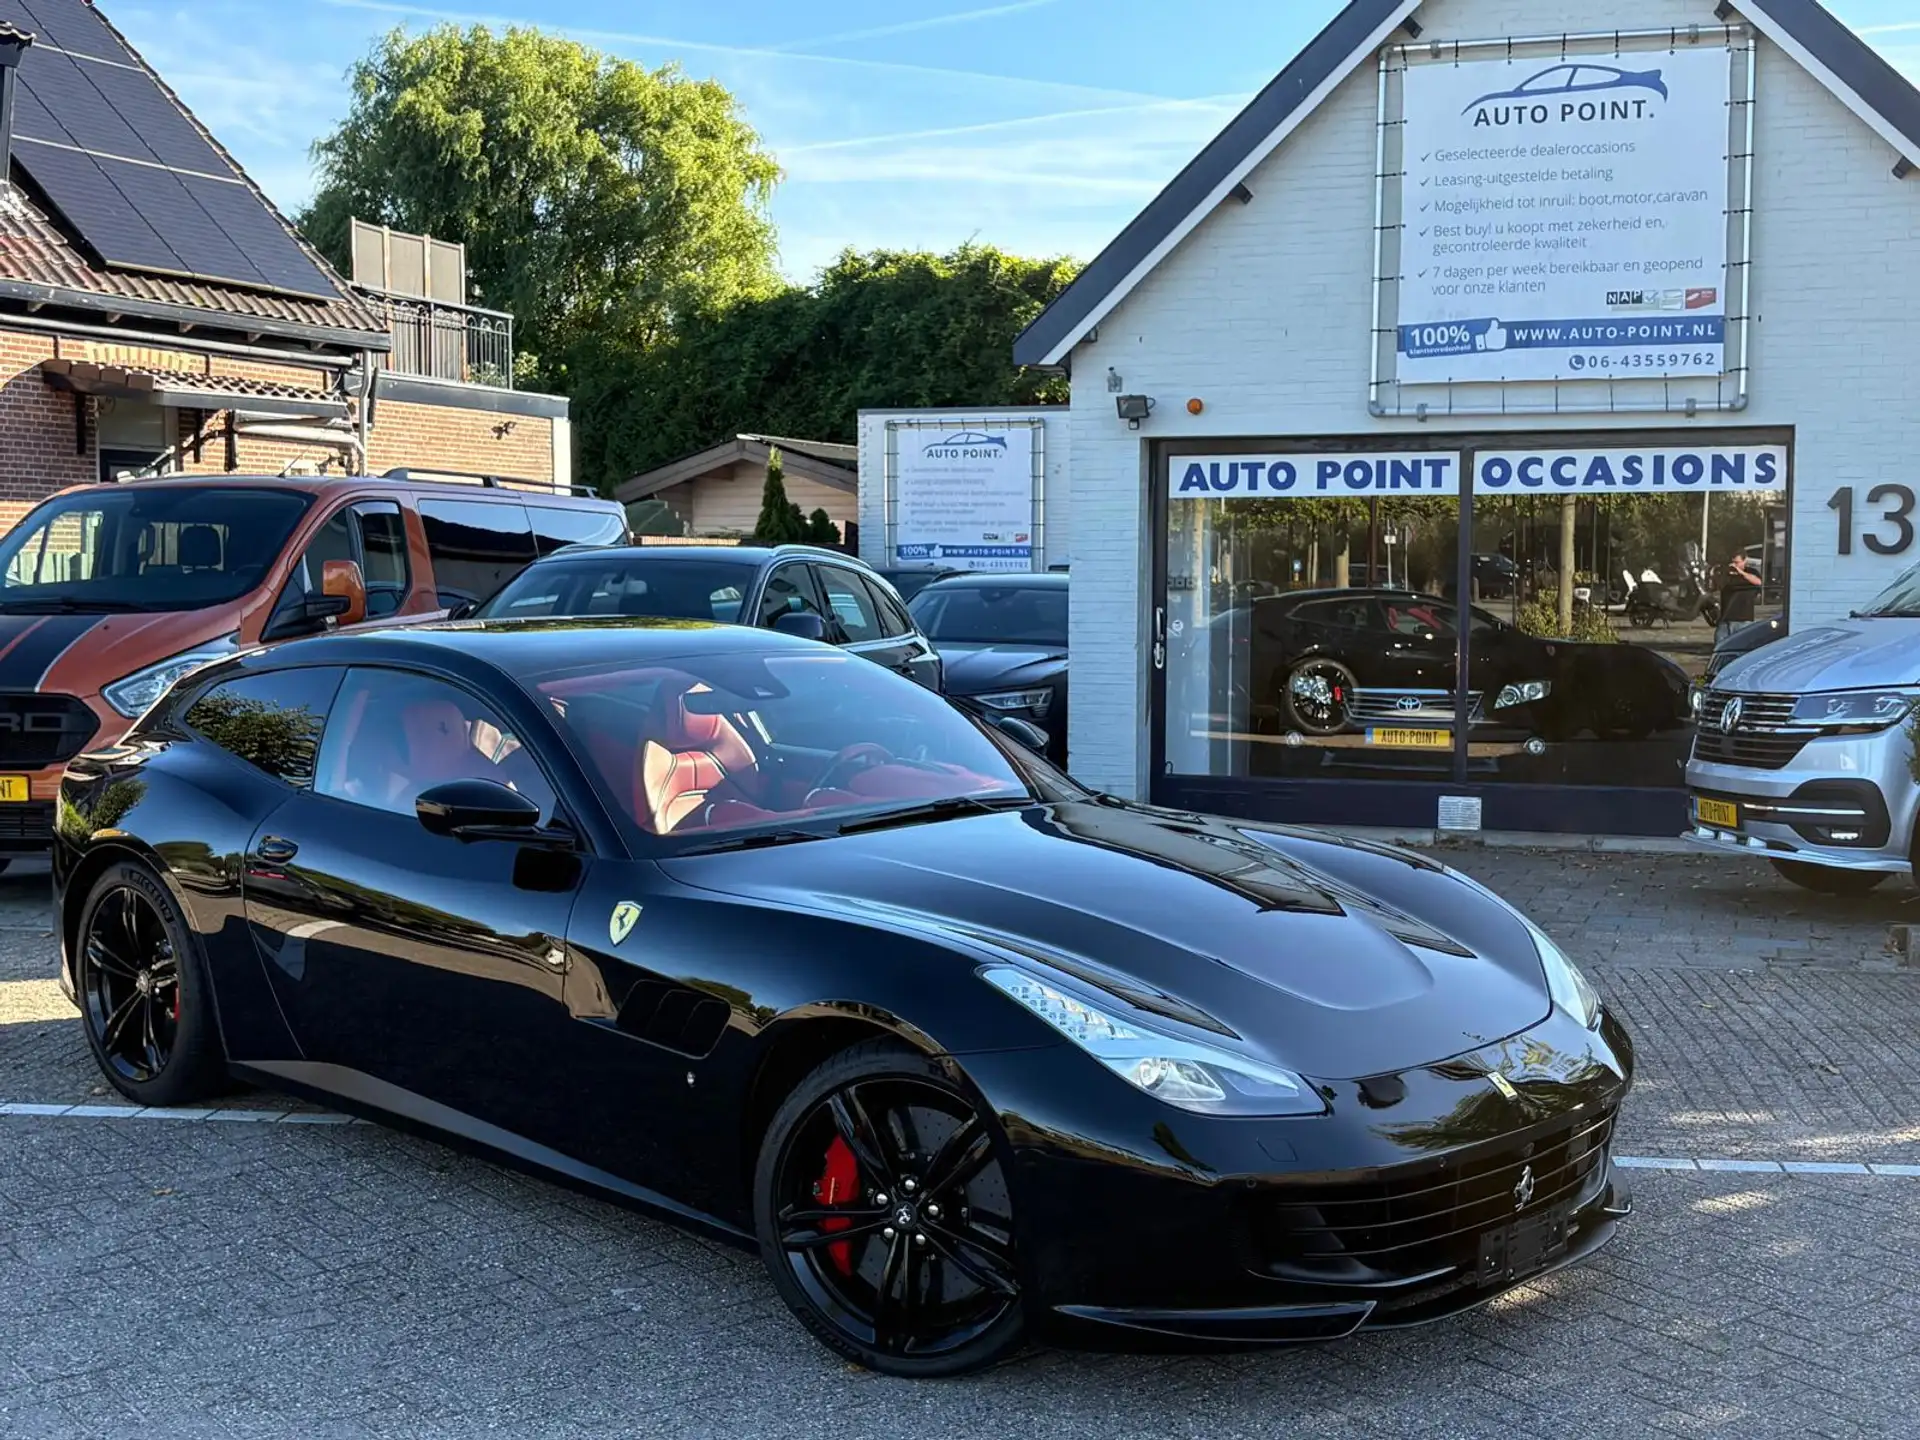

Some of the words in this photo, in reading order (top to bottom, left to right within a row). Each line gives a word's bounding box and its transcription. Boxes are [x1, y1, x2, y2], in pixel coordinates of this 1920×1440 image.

[1473, 104, 1548, 127] AUTO
[1435, 144, 1527, 162] Geselecteerde
[1530, 141, 1636, 157] dealeroccasions
[1434, 168, 1557, 187] Leasing-uitgestelde
[1562, 166, 1613, 182] betaling
[1434, 193, 1514, 214] Mogelijkheid
[1518, 196, 1536, 208] tot
[1539, 193, 1575, 207] inruil:
[1434, 224, 1461, 238] Best
[1465, 222, 1492, 238] buy!
[1495, 224, 1504, 234] u
[1507, 221, 1544, 236] koopt
[1548, 221, 1574, 232] met
[1577, 214, 1641, 232] zekerheid
[1432, 238, 1531, 257] gecontroleerde
[1534, 235, 1588, 250] kwaliteit
[1432, 266, 1440, 278] 7
[1444, 265, 1483, 281] dagen
[1487, 266, 1508, 280] per
[1512, 262, 1547, 275] week
[1550, 259, 1620, 274] bereikbaar
[1623, 261, 1640, 272] en
[1643, 255, 1703, 275] geopend
[1432, 284, 1460, 296] voor
[1464, 282, 1495, 294] onze
[1498, 279, 1546, 293] klanten
[1606, 289, 1643, 305] NAP
[1410, 325, 1470, 347] 100%
[1514, 324, 1716, 341] WWW.AUTO-POINT.NL
[1588, 353, 1715, 368] 06-43559762
[926, 449, 958, 459] AUTO
[1179, 461, 1297, 492] AUTO
[1316, 459, 1451, 490] POINT
[1481, 453, 1777, 488] OCCASIONS
[1827, 483, 1916, 556] 13
[902, 545, 928, 555] 100%
